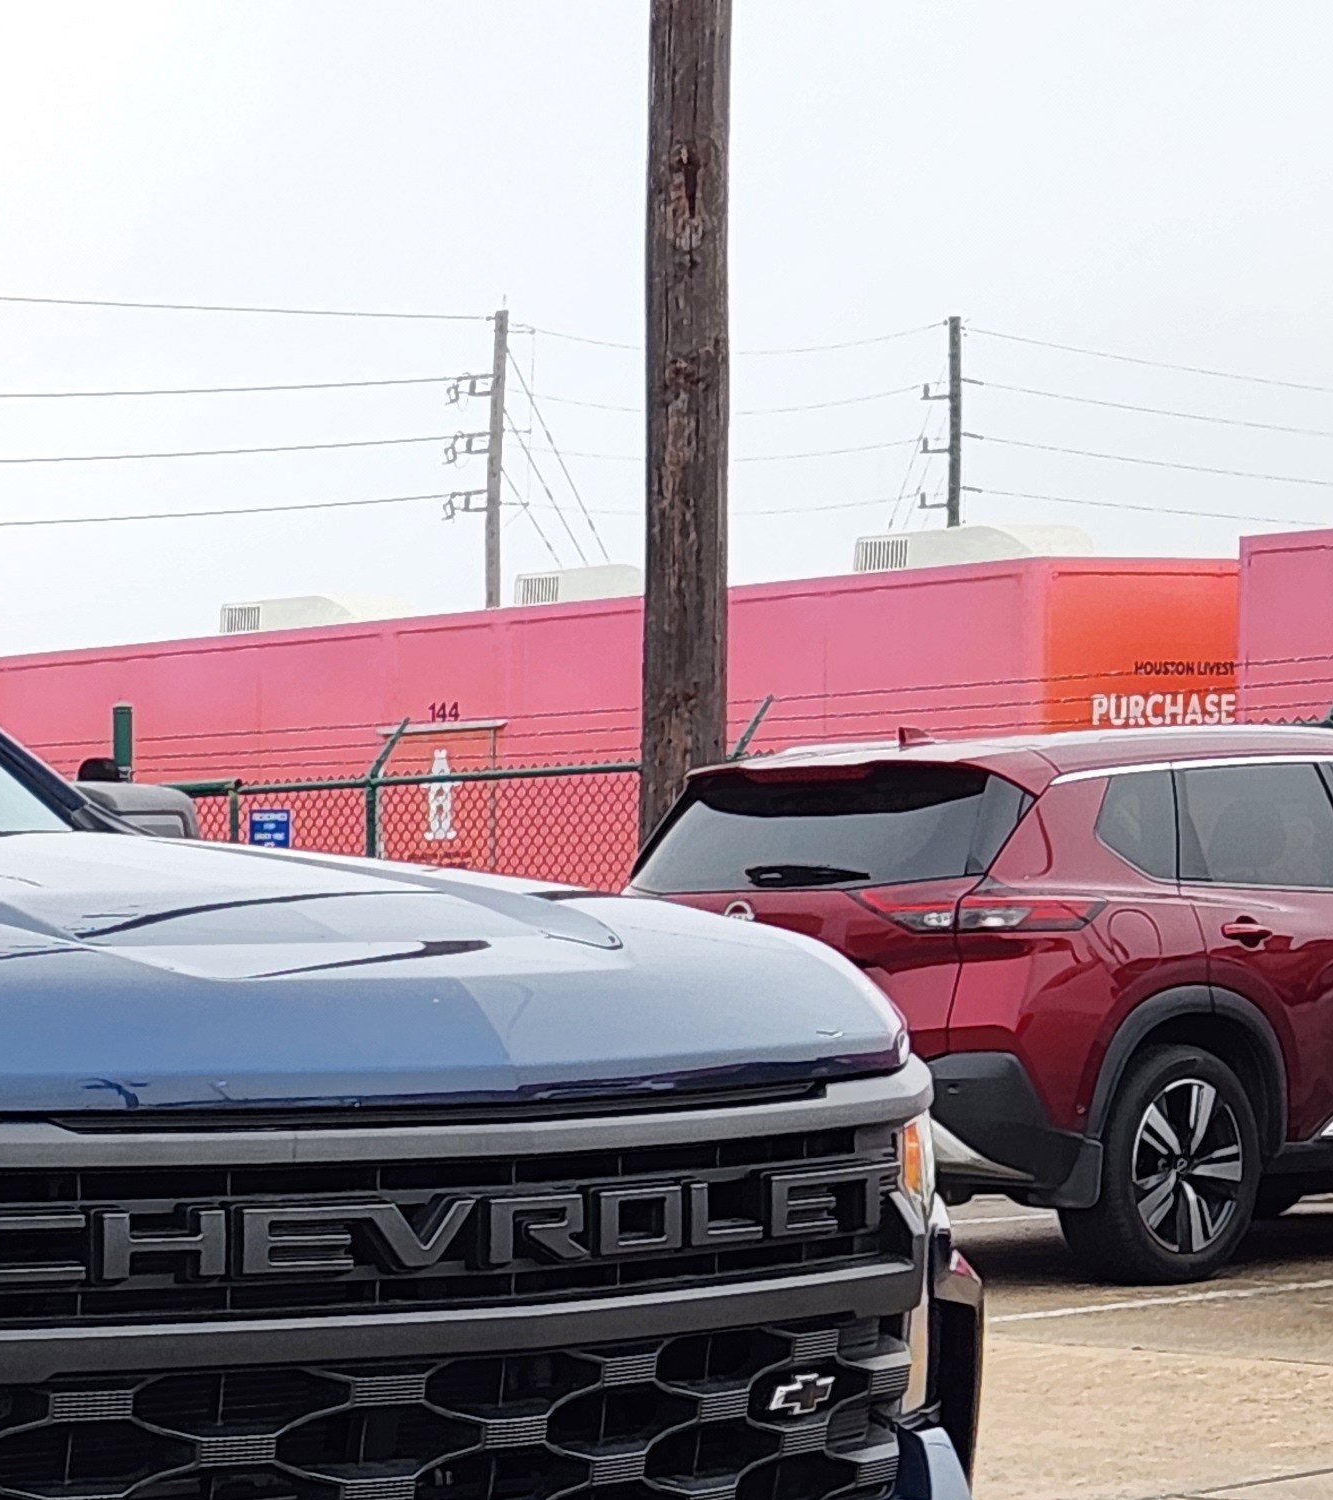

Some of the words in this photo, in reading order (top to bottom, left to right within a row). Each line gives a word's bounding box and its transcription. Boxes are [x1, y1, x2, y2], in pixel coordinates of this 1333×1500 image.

[1134, 660, 1195, 676] HOUSTON
[428, 701, 460, 722] 144
[1091, 692, 1236, 726] PURCHASE
